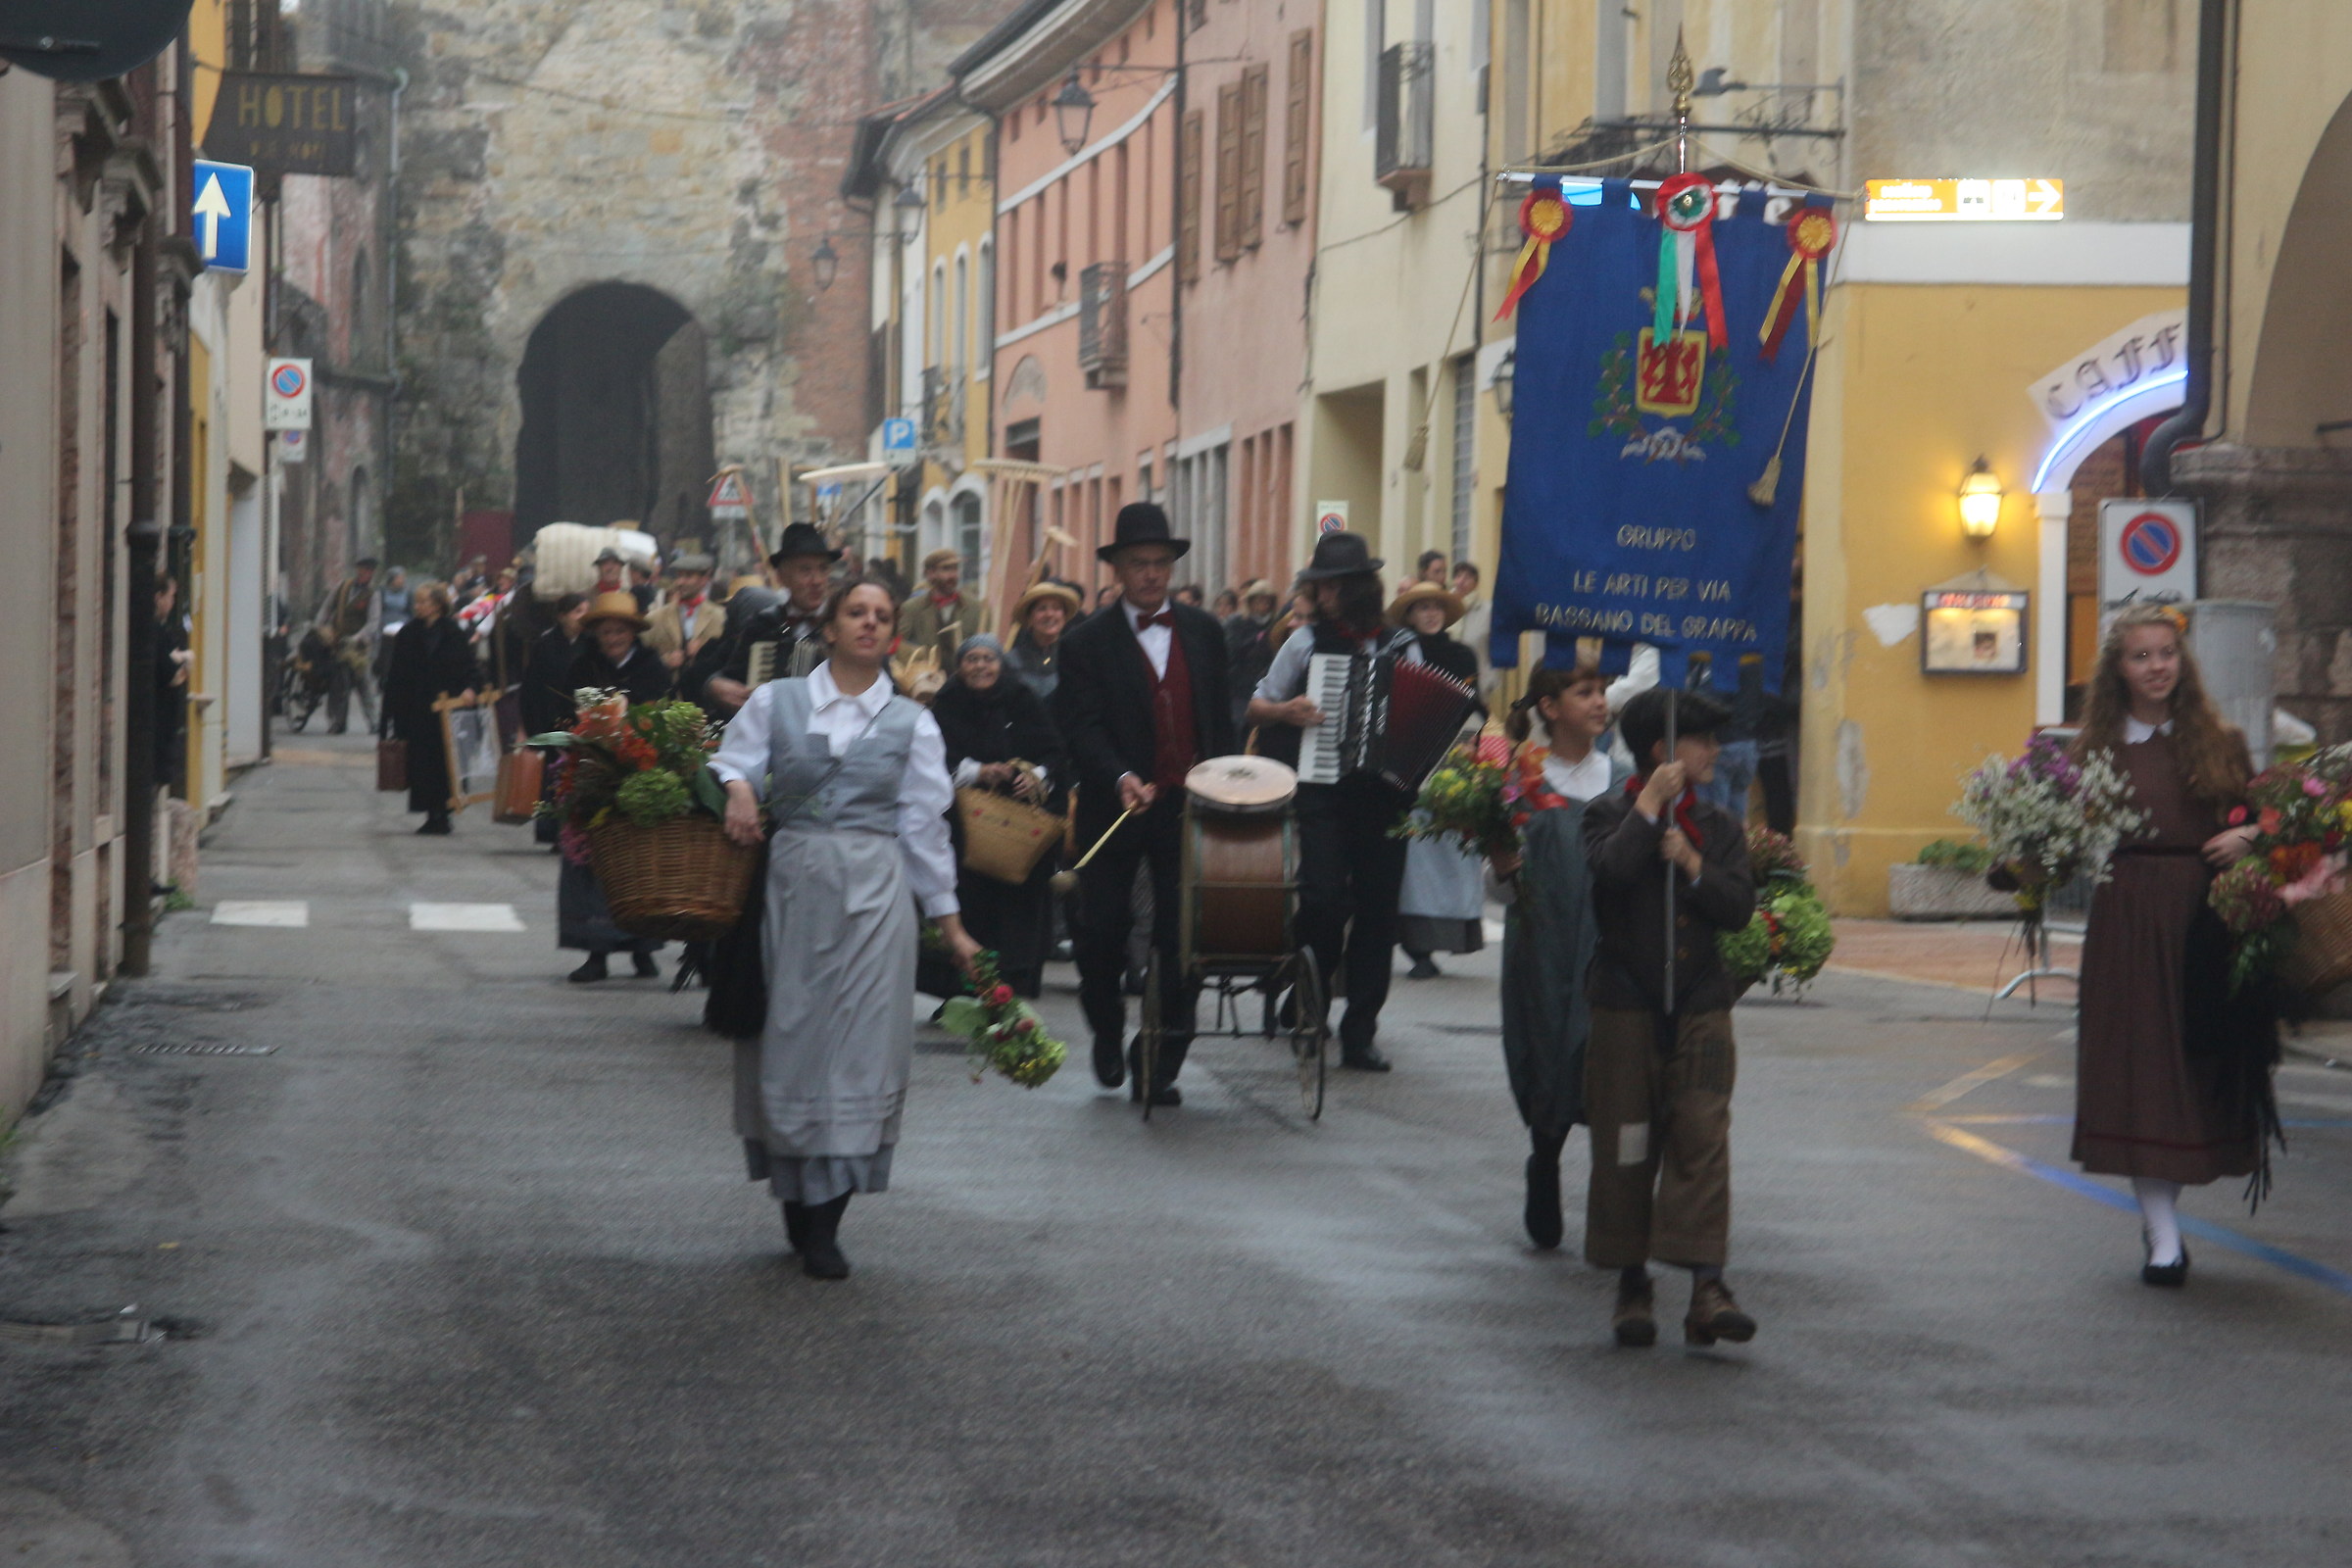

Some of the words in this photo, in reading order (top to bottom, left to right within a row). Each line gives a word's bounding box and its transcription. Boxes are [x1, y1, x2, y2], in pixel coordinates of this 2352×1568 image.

[238, 84, 347, 131] HOTEL
[2045, 320, 2183, 420] CAFF
[890, 421, 910, 445] P
[1617, 523, 1696, 552] GRUPPO
[1573, 570, 1596, 593] LE
[1604, 572, 1648, 599] ARTI
[1655, 576, 1690, 601] PER
[1697, 579, 1732, 603] VIA
[1535, 603, 1634, 633] BASSANO
[1640, 612, 1677, 637] DEL
[1682, 614, 1758, 643] GRAPPA
